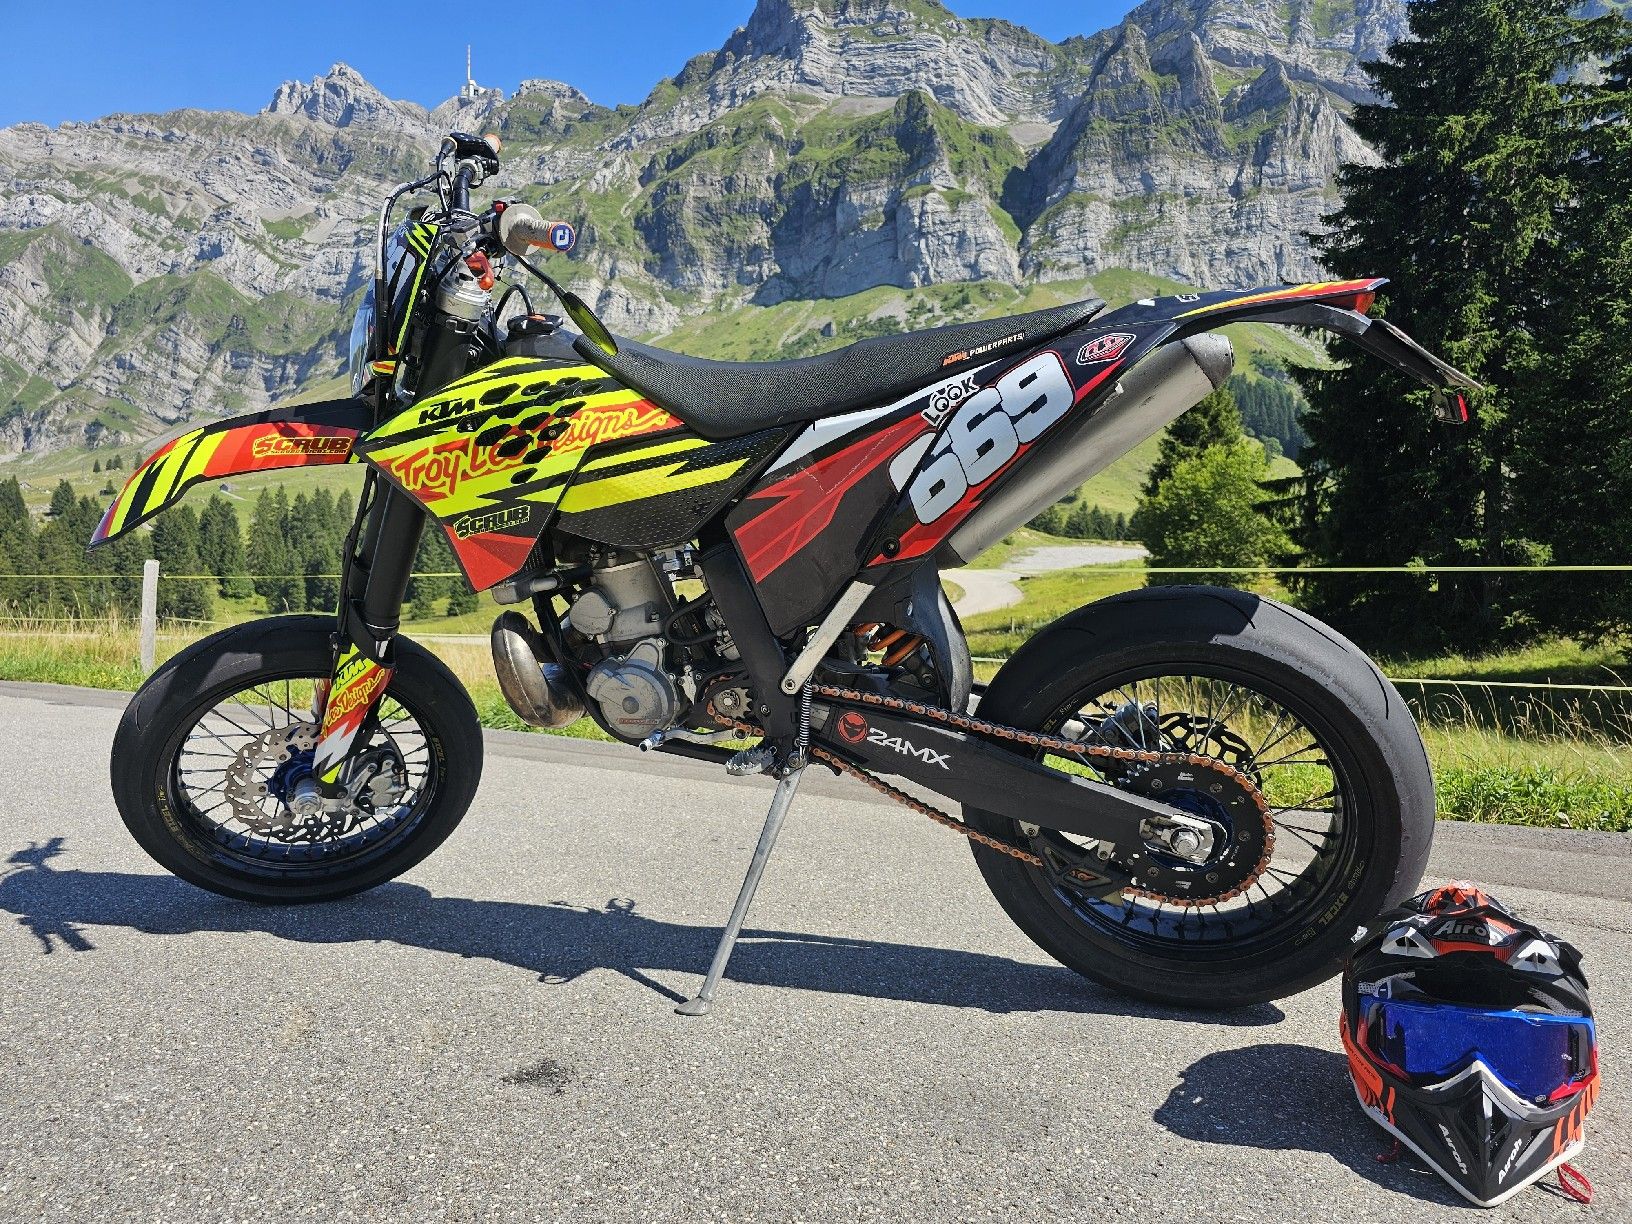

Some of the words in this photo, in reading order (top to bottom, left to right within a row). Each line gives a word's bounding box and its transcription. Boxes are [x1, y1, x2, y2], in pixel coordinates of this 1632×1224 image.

[969, 332, 1024, 357] POWERPARTS
[417, 397, 476, 425] KTM
[923, 376, 979, 424] LOOK
[252, 432, 352, 458] SCRUB
[889, 351, 1075, 526] 669
[393, 445, 462, 495] Troy
[453, 505, 531, 540] SCRUB
[866, 727, 951, 770] 24MX
[1433, 919, 1497, 941] Airo
[1438, 1123, 1468, 1173] Airoh
[1498, 1138, 1523, 1185] Airoh
